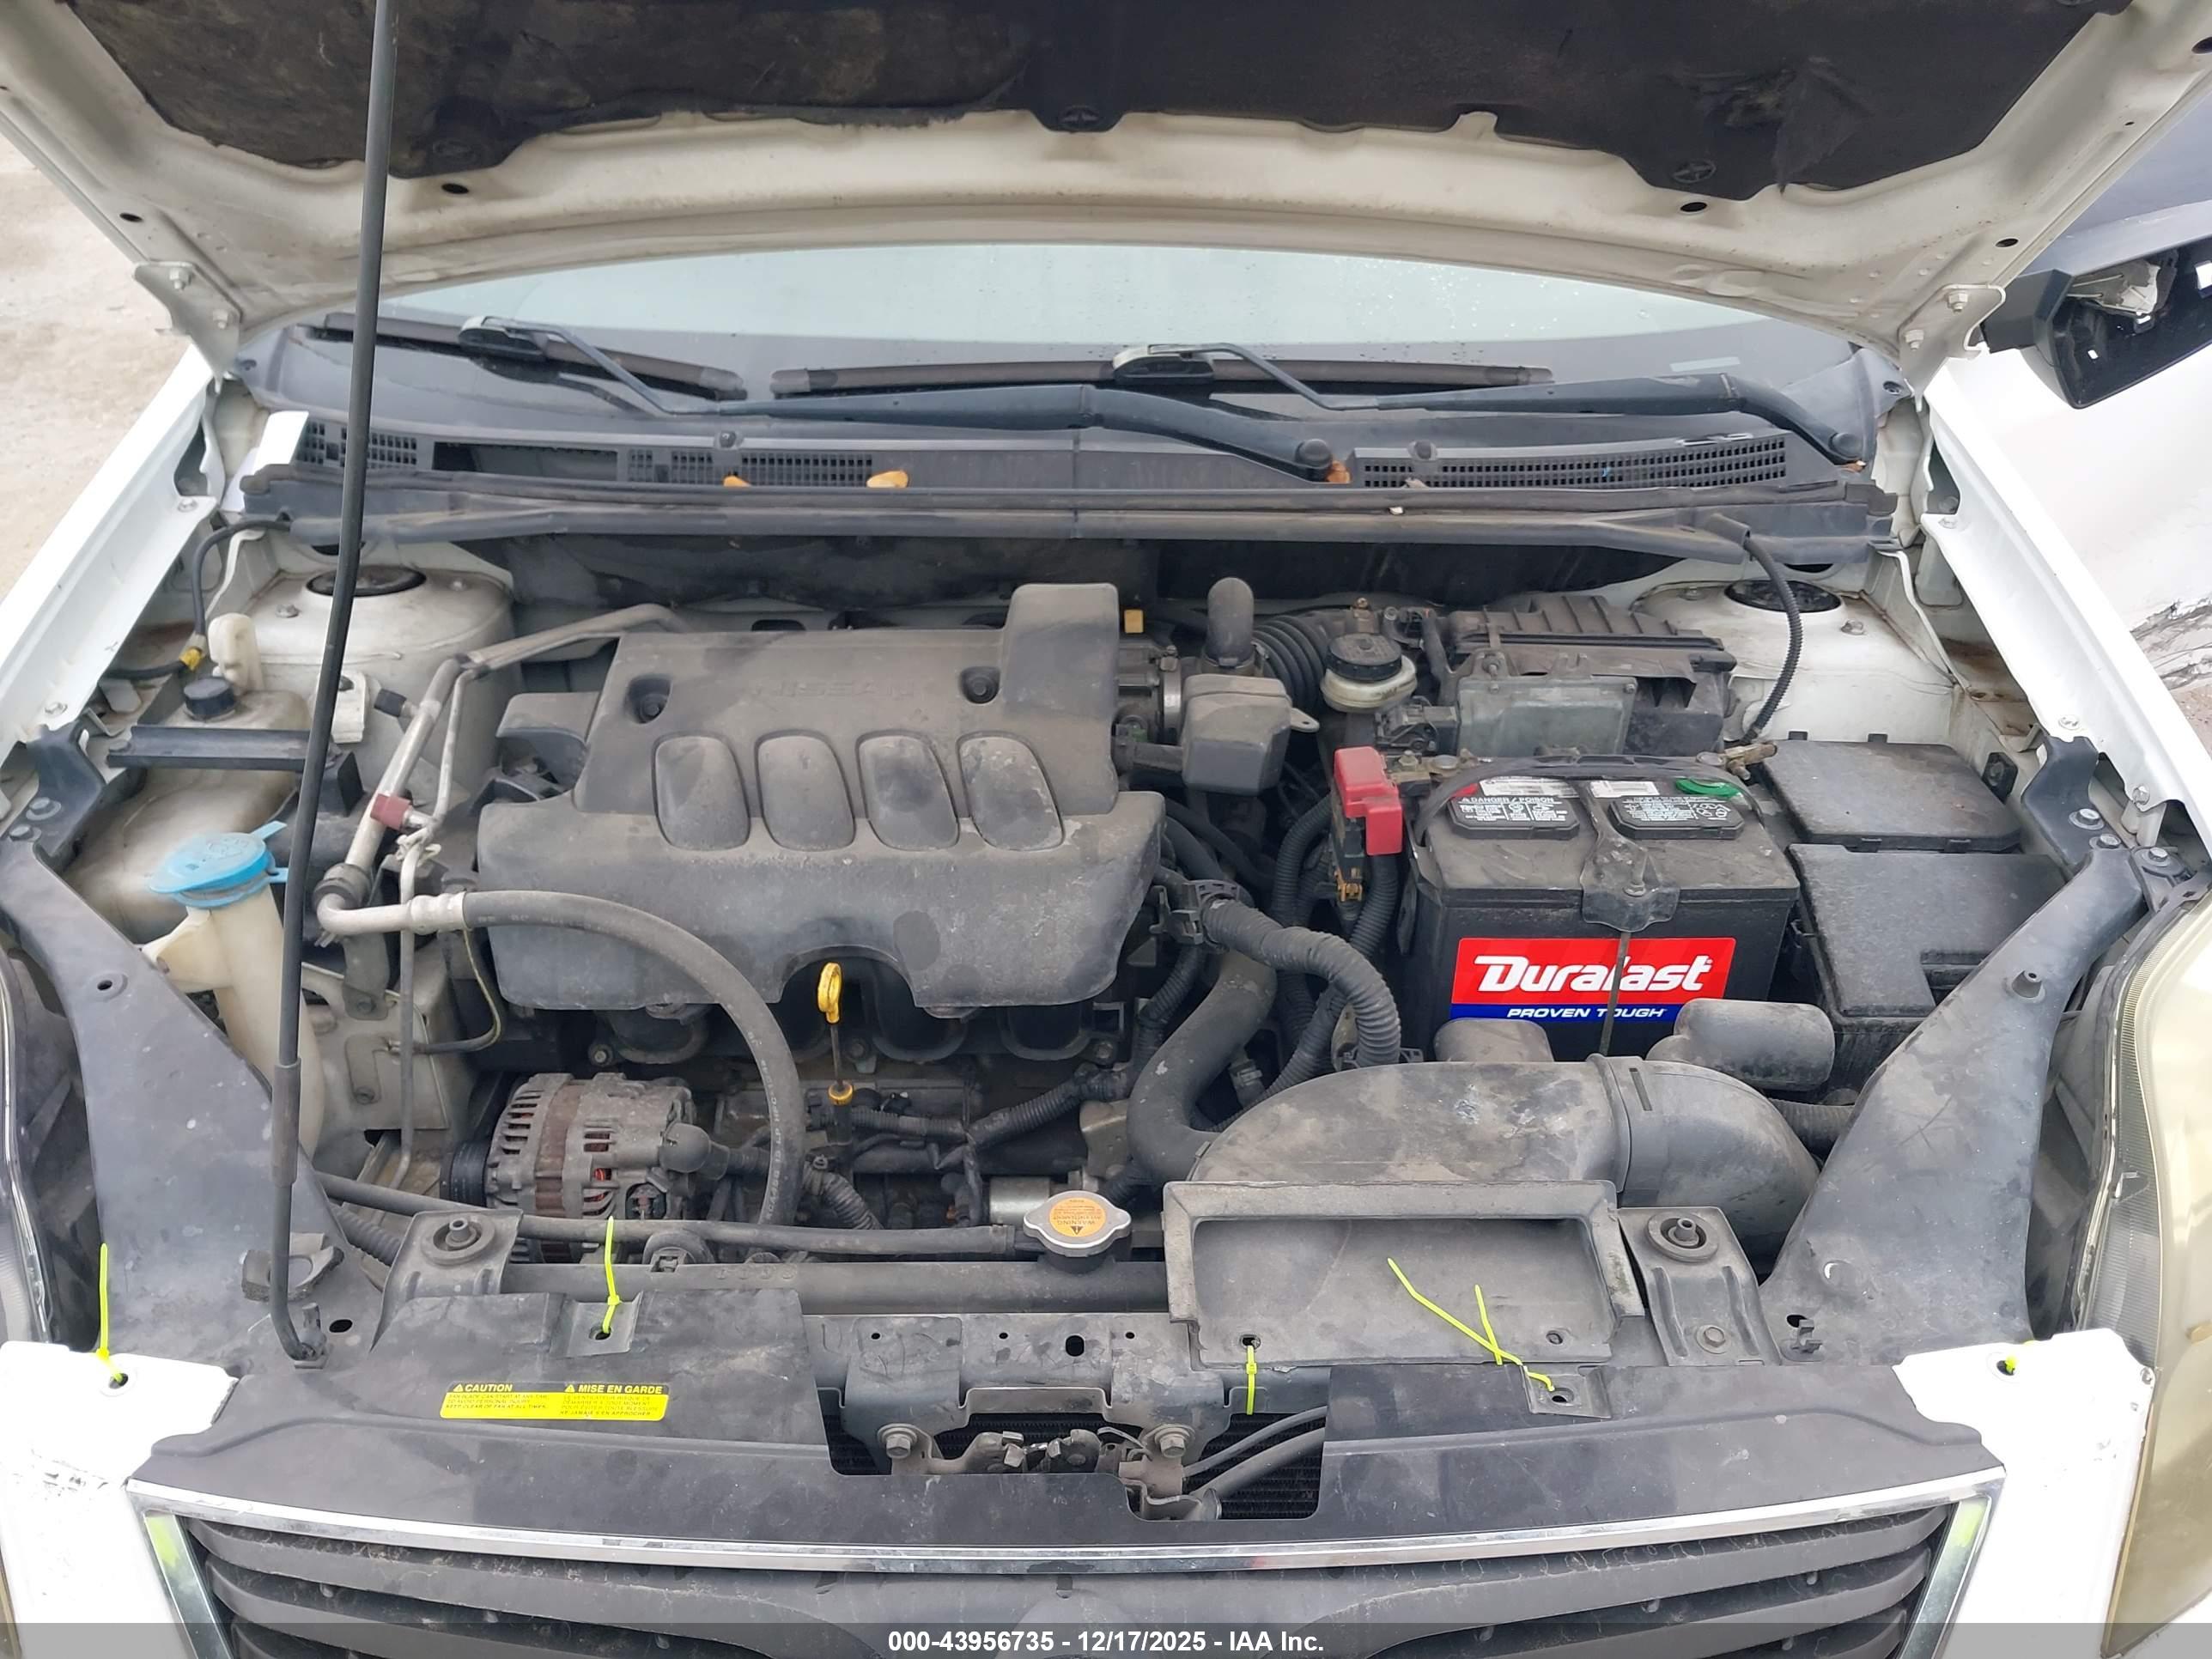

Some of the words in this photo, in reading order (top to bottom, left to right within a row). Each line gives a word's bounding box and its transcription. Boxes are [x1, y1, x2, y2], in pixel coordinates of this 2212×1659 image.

[1507, 1008, 1591, 1018] PROVEN
[465, 1383, 513, 1392] CAUTION
[578, 1384, 605, 1393] MISE
[606, 1385, 623, 1394] EN
[624, 1386, 663, 1395] GARDE
